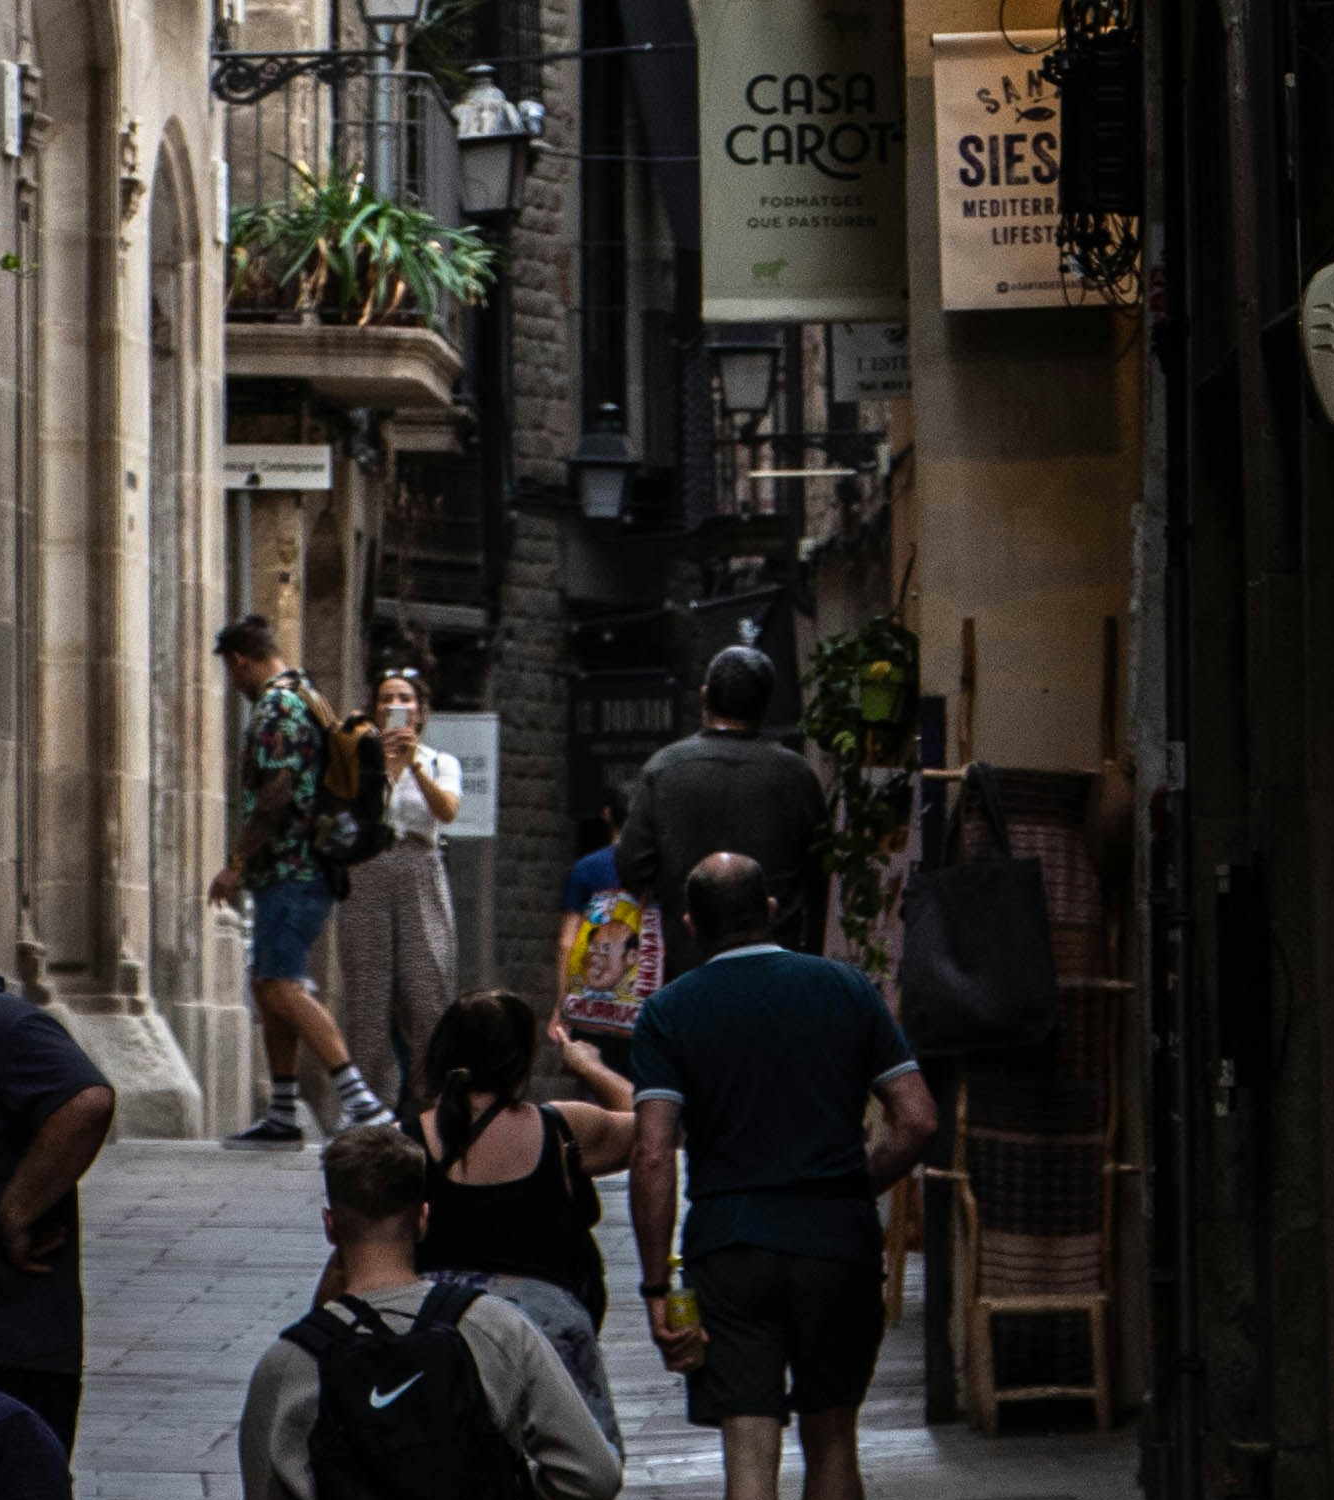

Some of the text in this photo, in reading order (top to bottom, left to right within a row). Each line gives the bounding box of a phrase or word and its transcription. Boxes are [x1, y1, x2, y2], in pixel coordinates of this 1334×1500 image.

[745, 73, 875, 115] CASA
[977, 69, 1063, 114] SAN
[959, 132, 1060, 187] SIES
[760, 195, 864, 209] FORMATGES
[963, 198, 1061, 218] MEDITERR
[746, 215, 878, 229] QUE PASTUREN
[992, 225, 1058, 245] LIFEST
